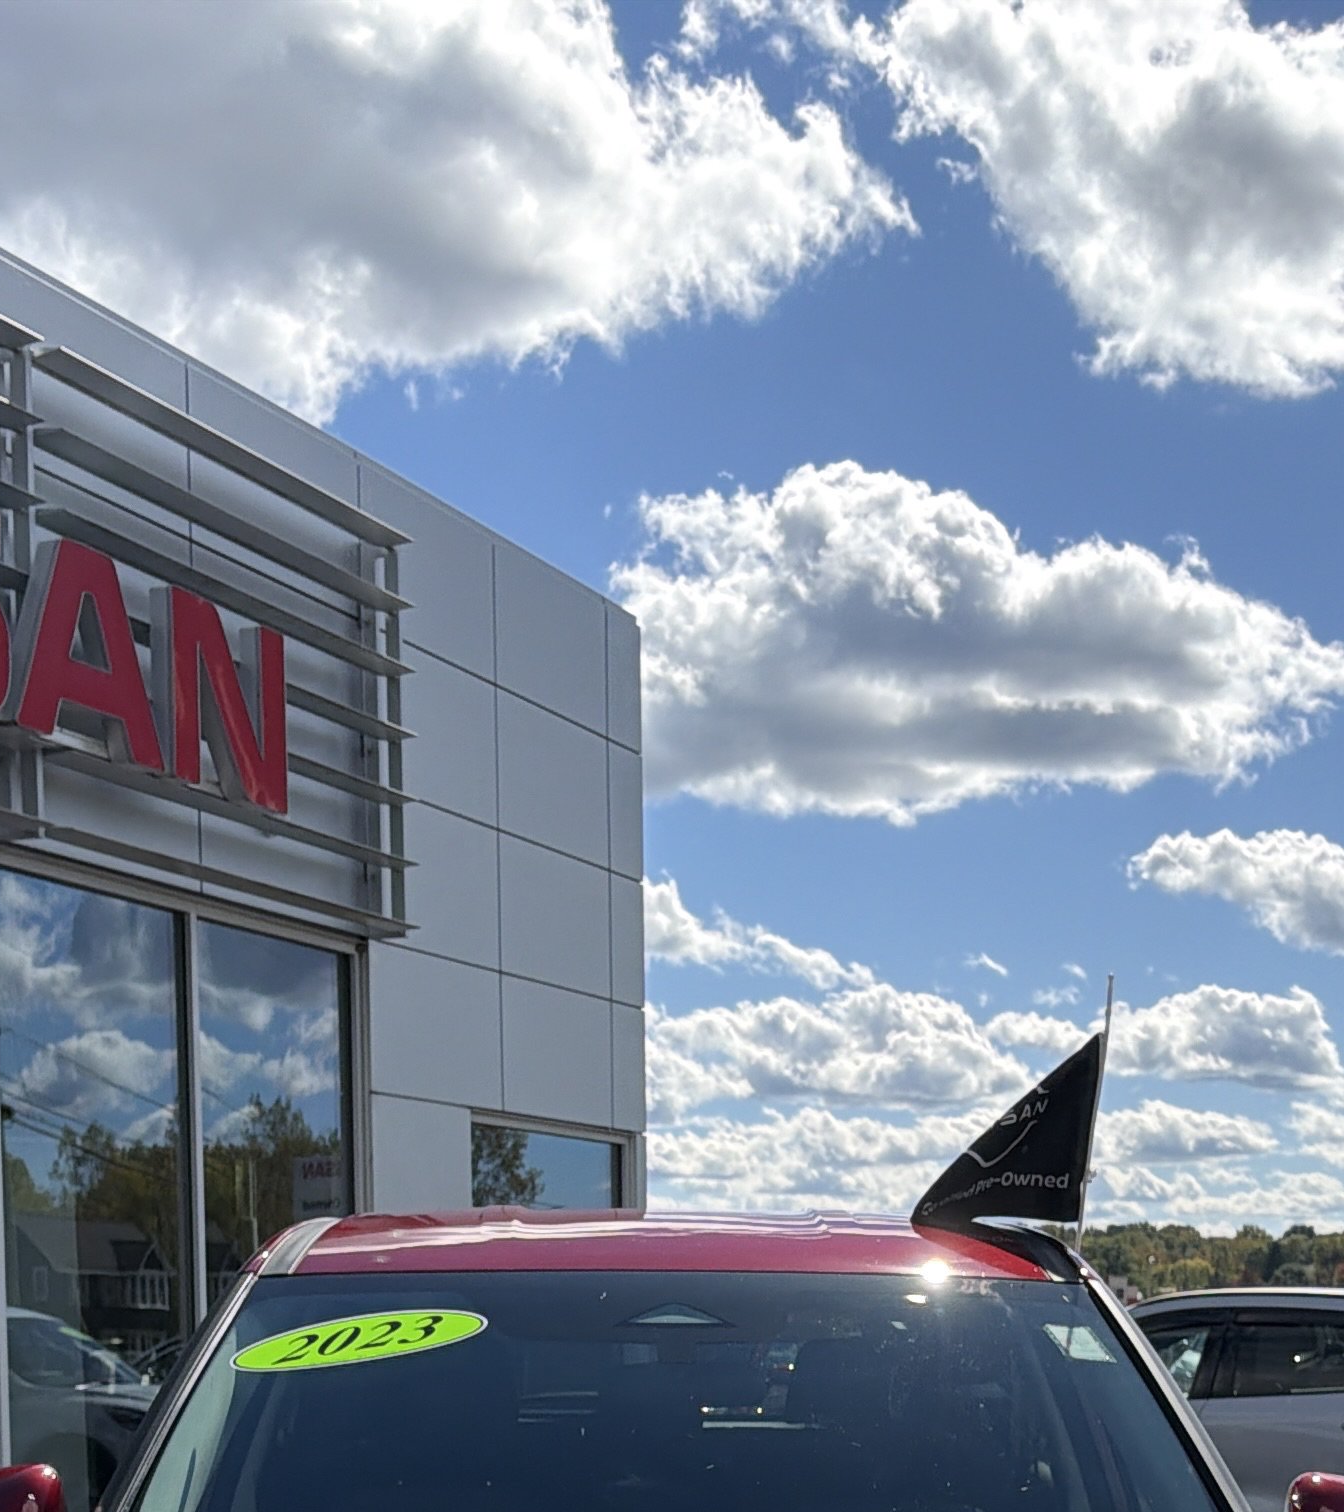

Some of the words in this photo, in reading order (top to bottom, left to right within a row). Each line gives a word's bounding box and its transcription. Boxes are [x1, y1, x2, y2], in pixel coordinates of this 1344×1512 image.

[999, 1098, 1049, 1126] SAN
[975, 1171, 1070, 1193] Pre-Owned
[271, 1315, 443, 1366] 2023
